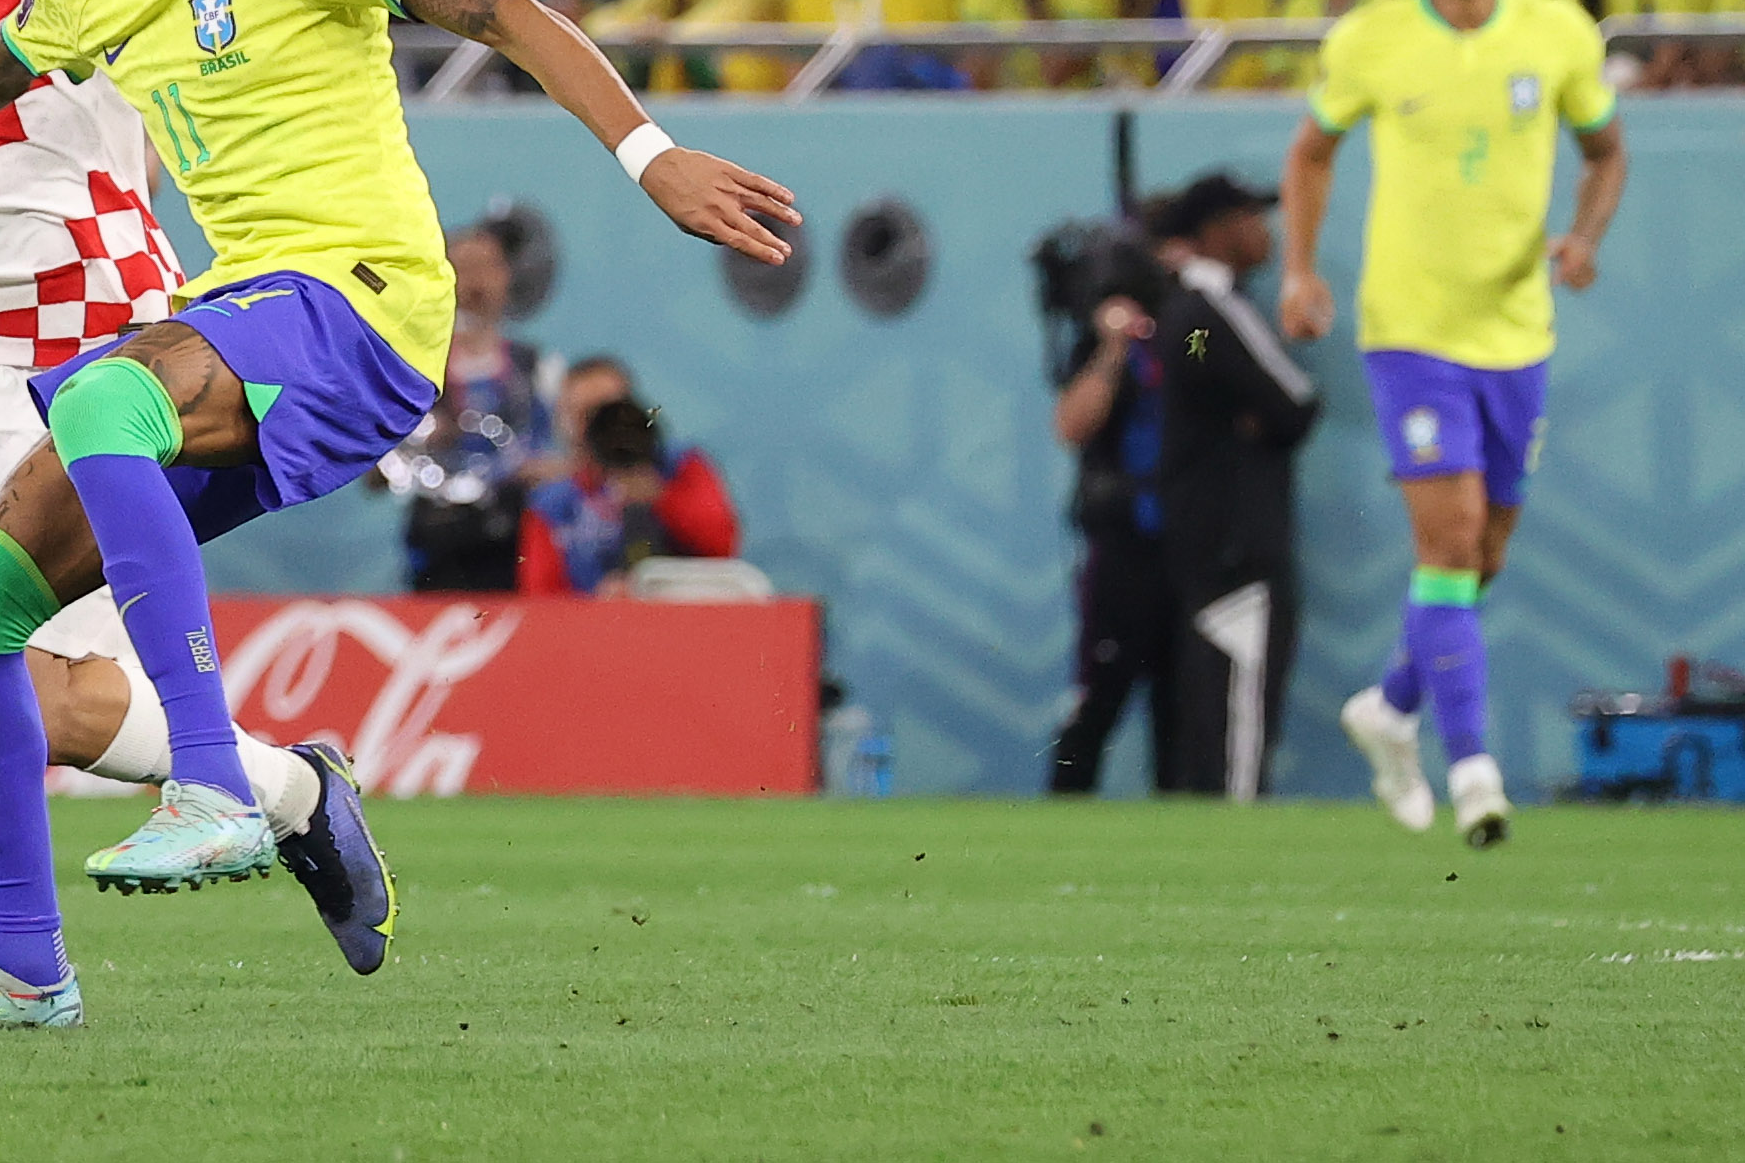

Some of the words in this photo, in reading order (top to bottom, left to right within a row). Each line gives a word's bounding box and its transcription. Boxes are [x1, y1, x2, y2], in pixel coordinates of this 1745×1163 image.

[203, 10, 219, 22] CBF
[200, 51, 251, 76] BRASIL
[152, 82, 210, 174] 11
[185, 625, 216, 673] BRASIL
